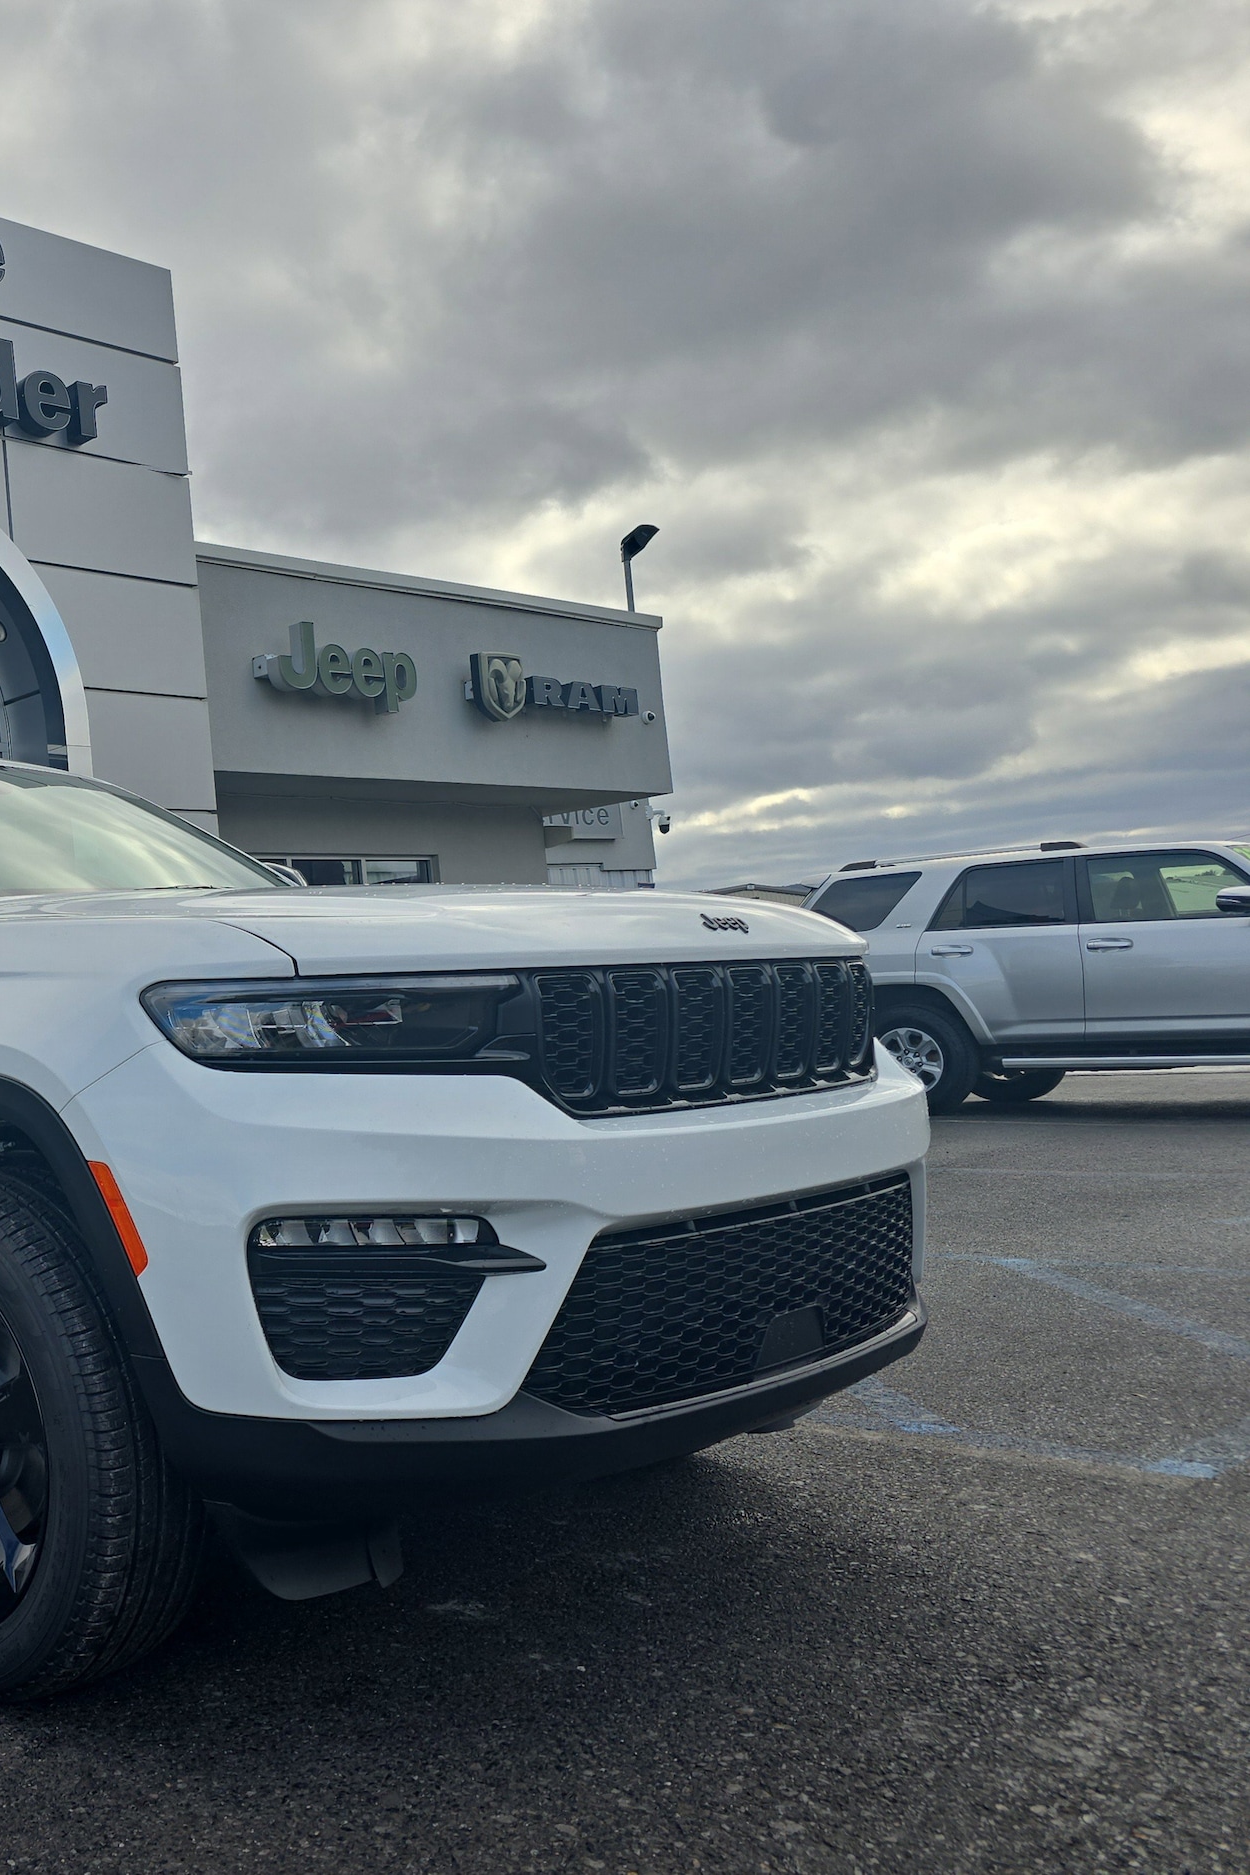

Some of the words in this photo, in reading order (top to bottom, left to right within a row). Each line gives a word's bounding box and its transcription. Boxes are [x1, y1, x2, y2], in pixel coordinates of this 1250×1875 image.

[268, 621, 417, 714] Jeep
[525, 675, 639, 717] RAM
[699, 913, 749, 934] Jeep
